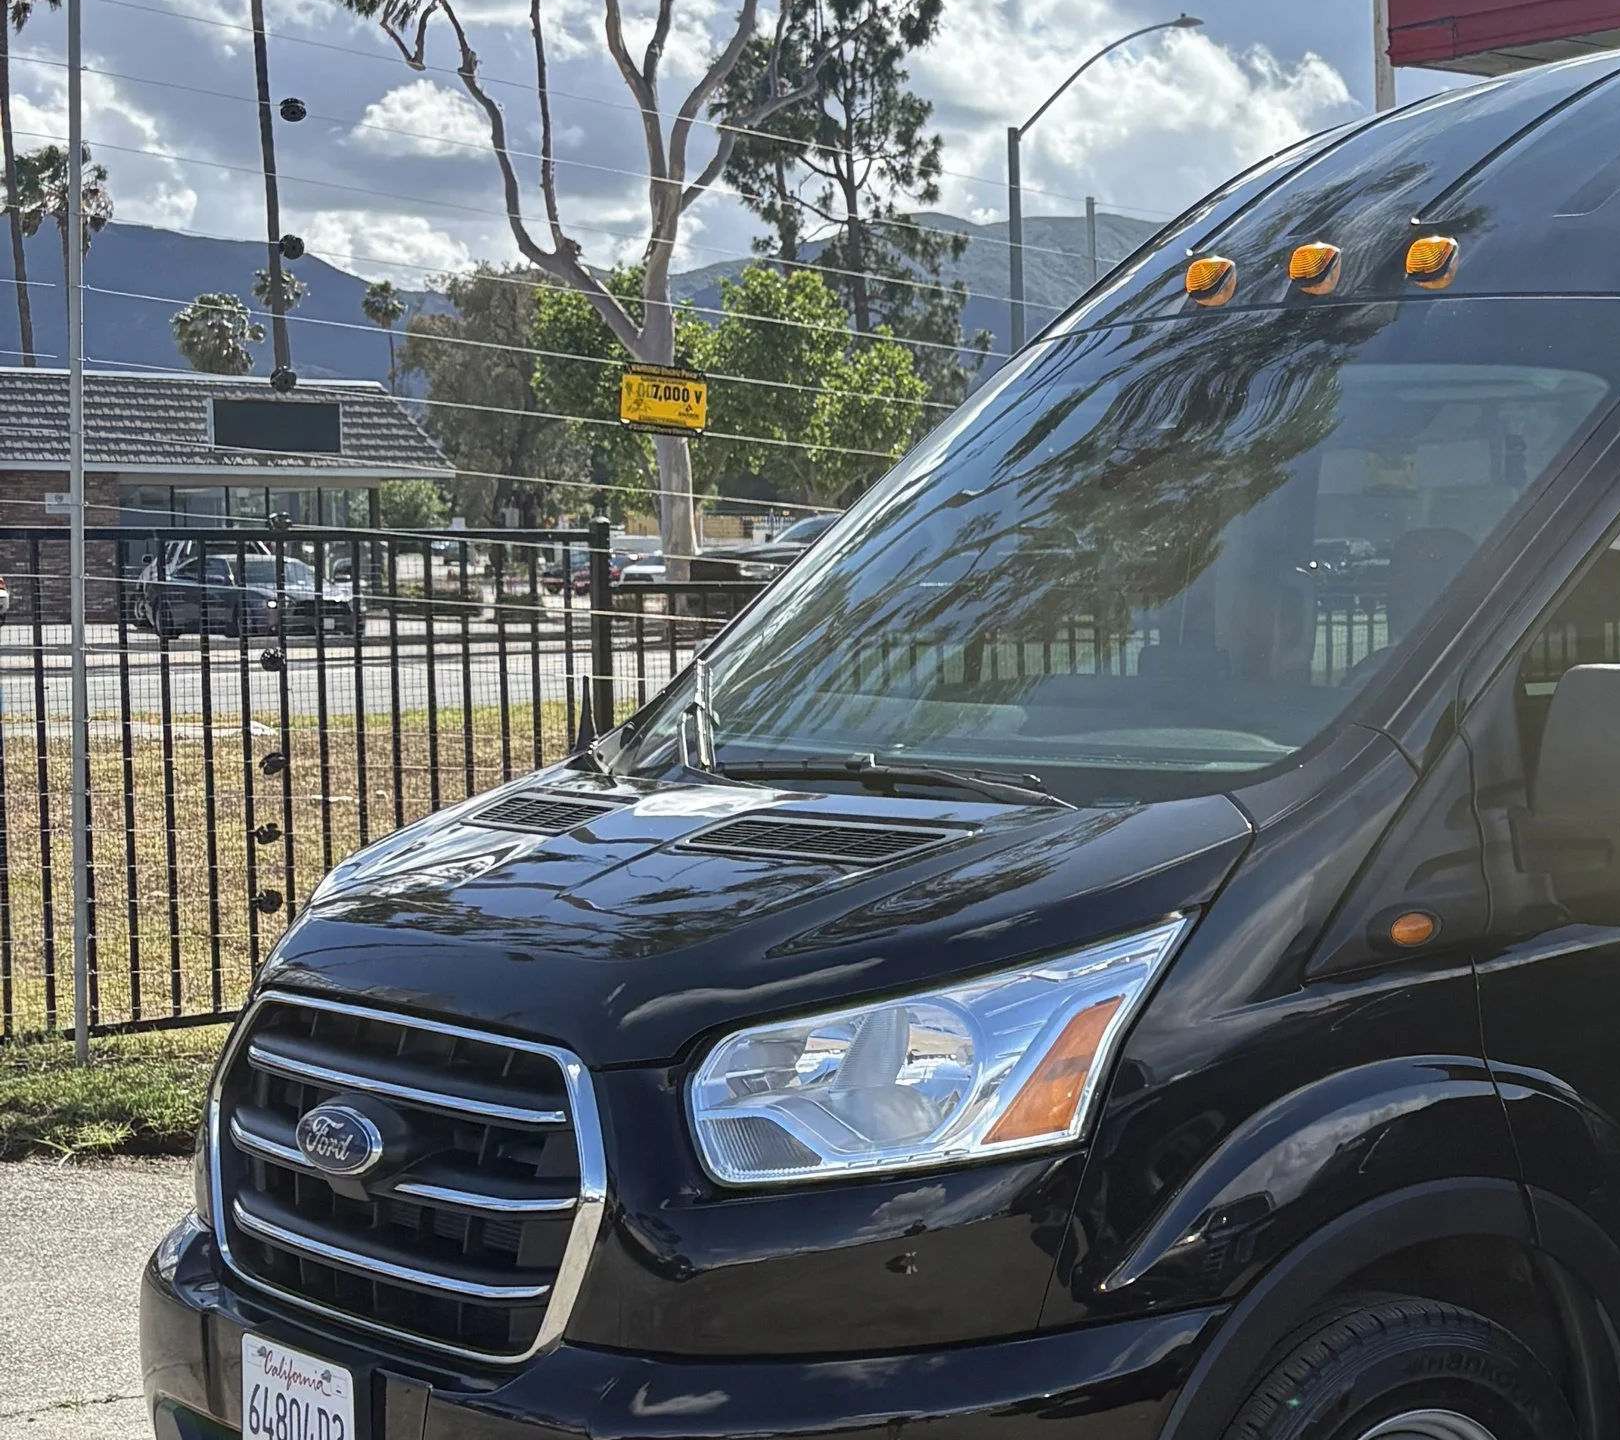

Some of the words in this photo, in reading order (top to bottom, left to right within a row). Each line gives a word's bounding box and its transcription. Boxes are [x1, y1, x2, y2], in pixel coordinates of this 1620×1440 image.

[651, 384, 690, 403] 7,000
[694, 390, 703, 405] V
[305, 1116, 354, 1160] Ford
[263, 1350, 333, 1397] California
